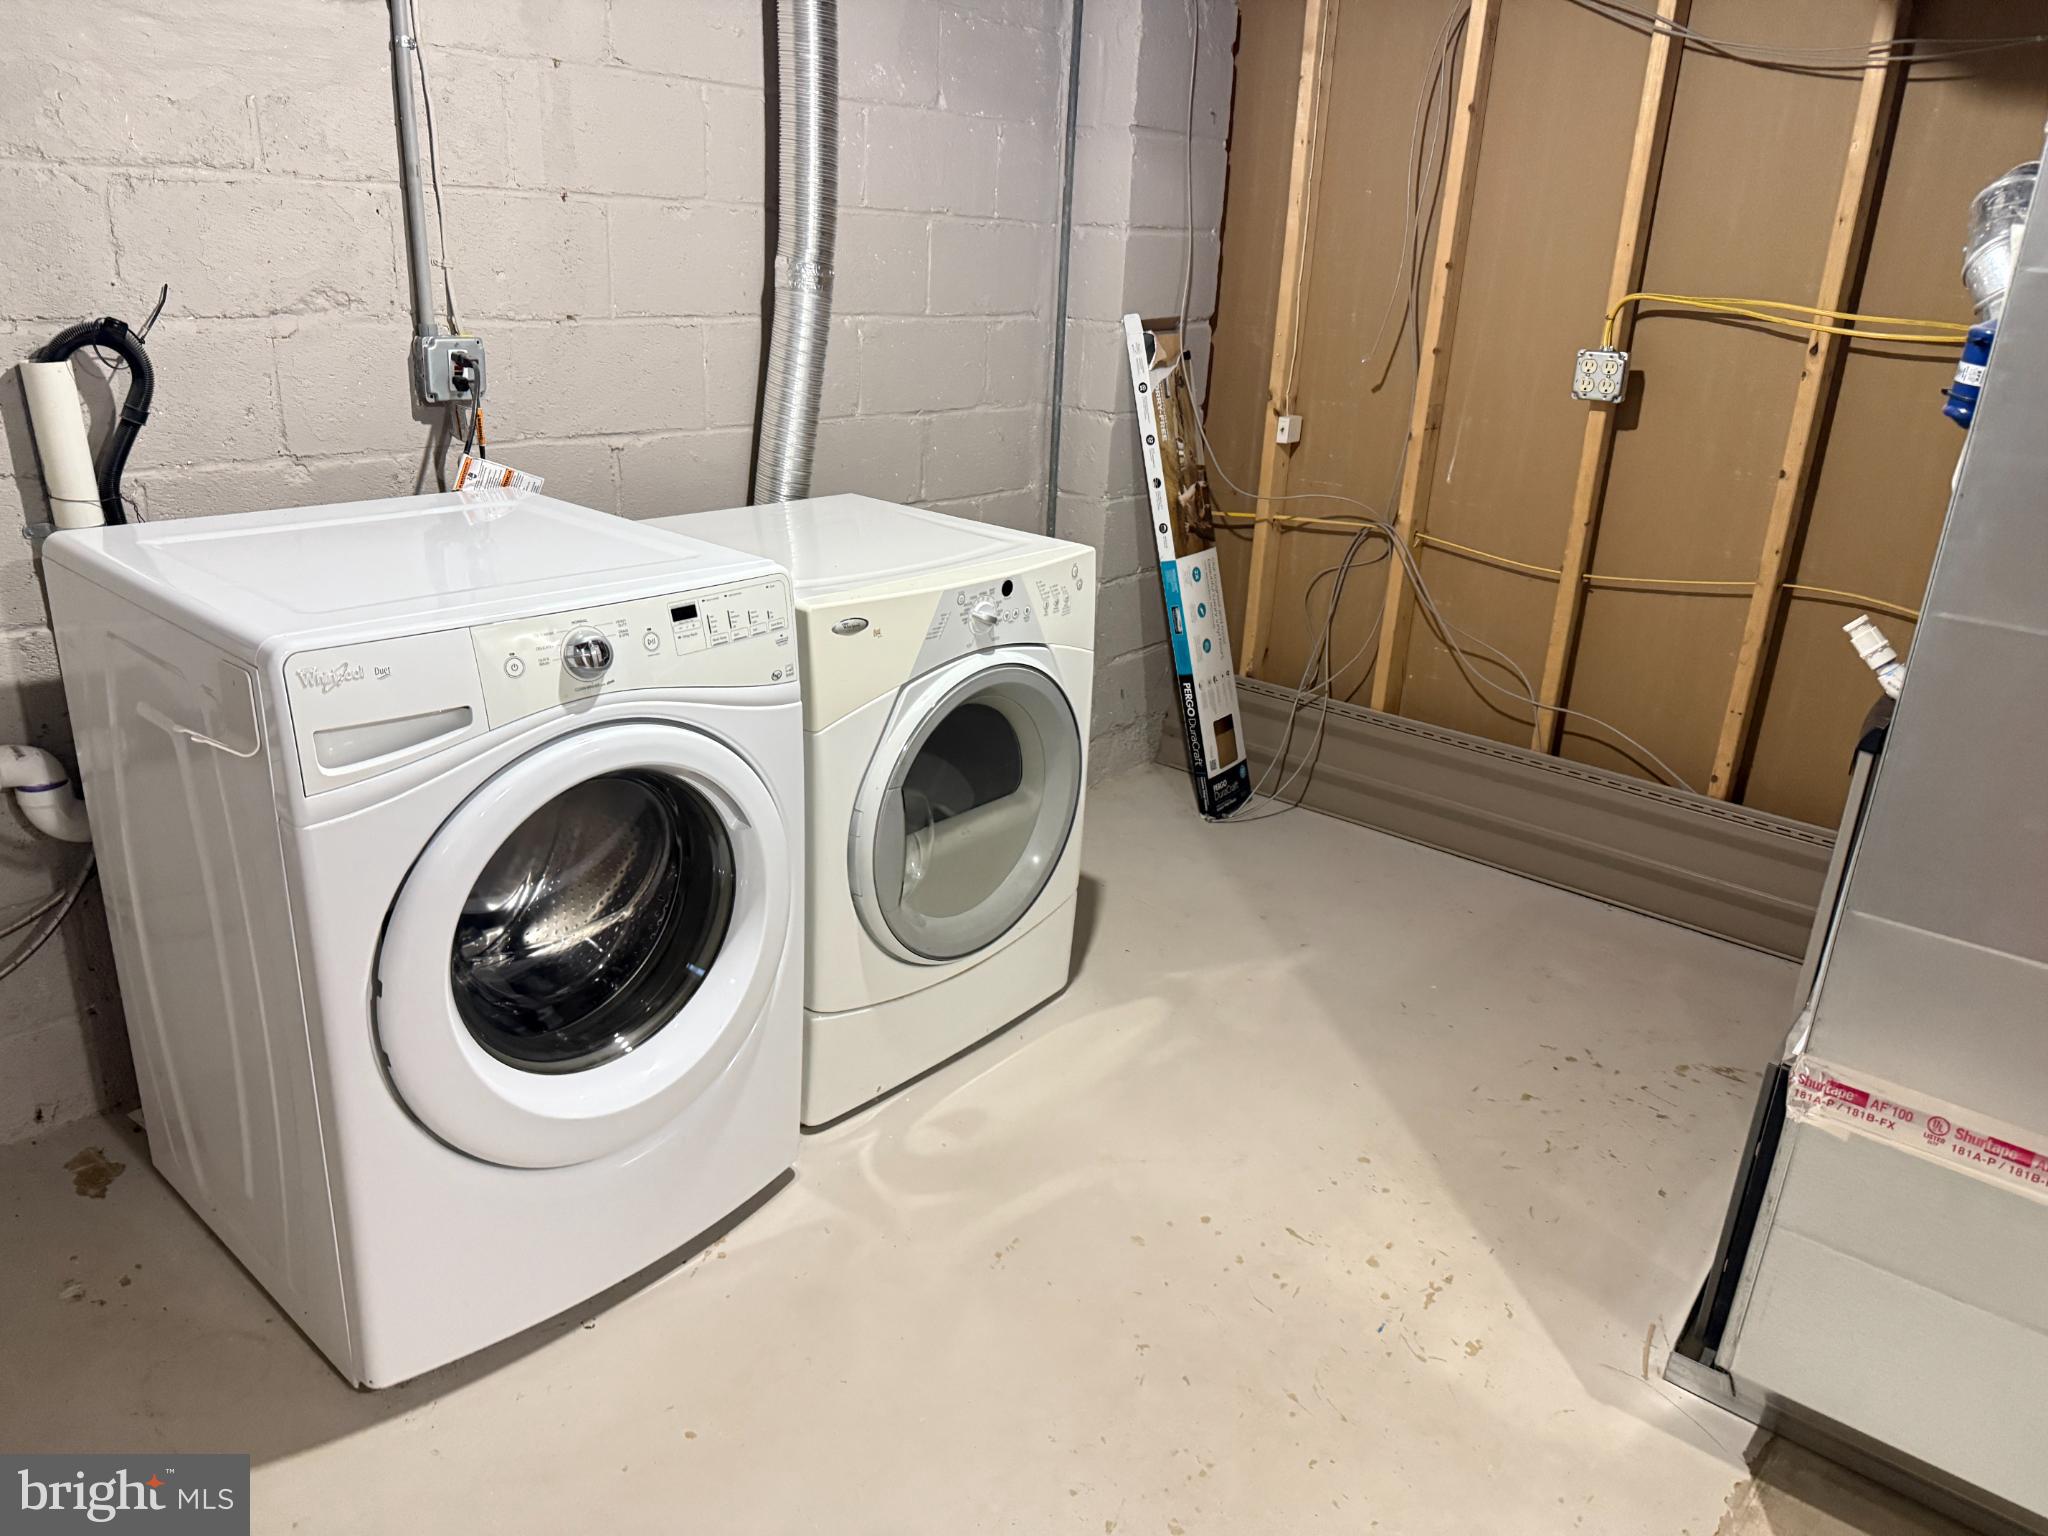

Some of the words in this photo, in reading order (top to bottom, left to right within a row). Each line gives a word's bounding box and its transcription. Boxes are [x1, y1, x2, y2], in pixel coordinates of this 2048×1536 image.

[1154, 383, 1167, 442] ORRY-FREE
[1182, 682, 1196, 717] PERGO
[1188, 717, 1203, 767] DuraCraft
[1794, 1088, 1836, 1108] 181A-P
[1846, 1105, 1896, 1131] 181B-FX
[1870, 1099, 1890, 1112] AF
[1892, 1106, 1914, 1123] 100
[1954, 1127, 2018, 1159] Shurtape
[1952, 1144, 1997, 1166] 181A-P
[2008, 1165, 2048, 1187] 181B-
